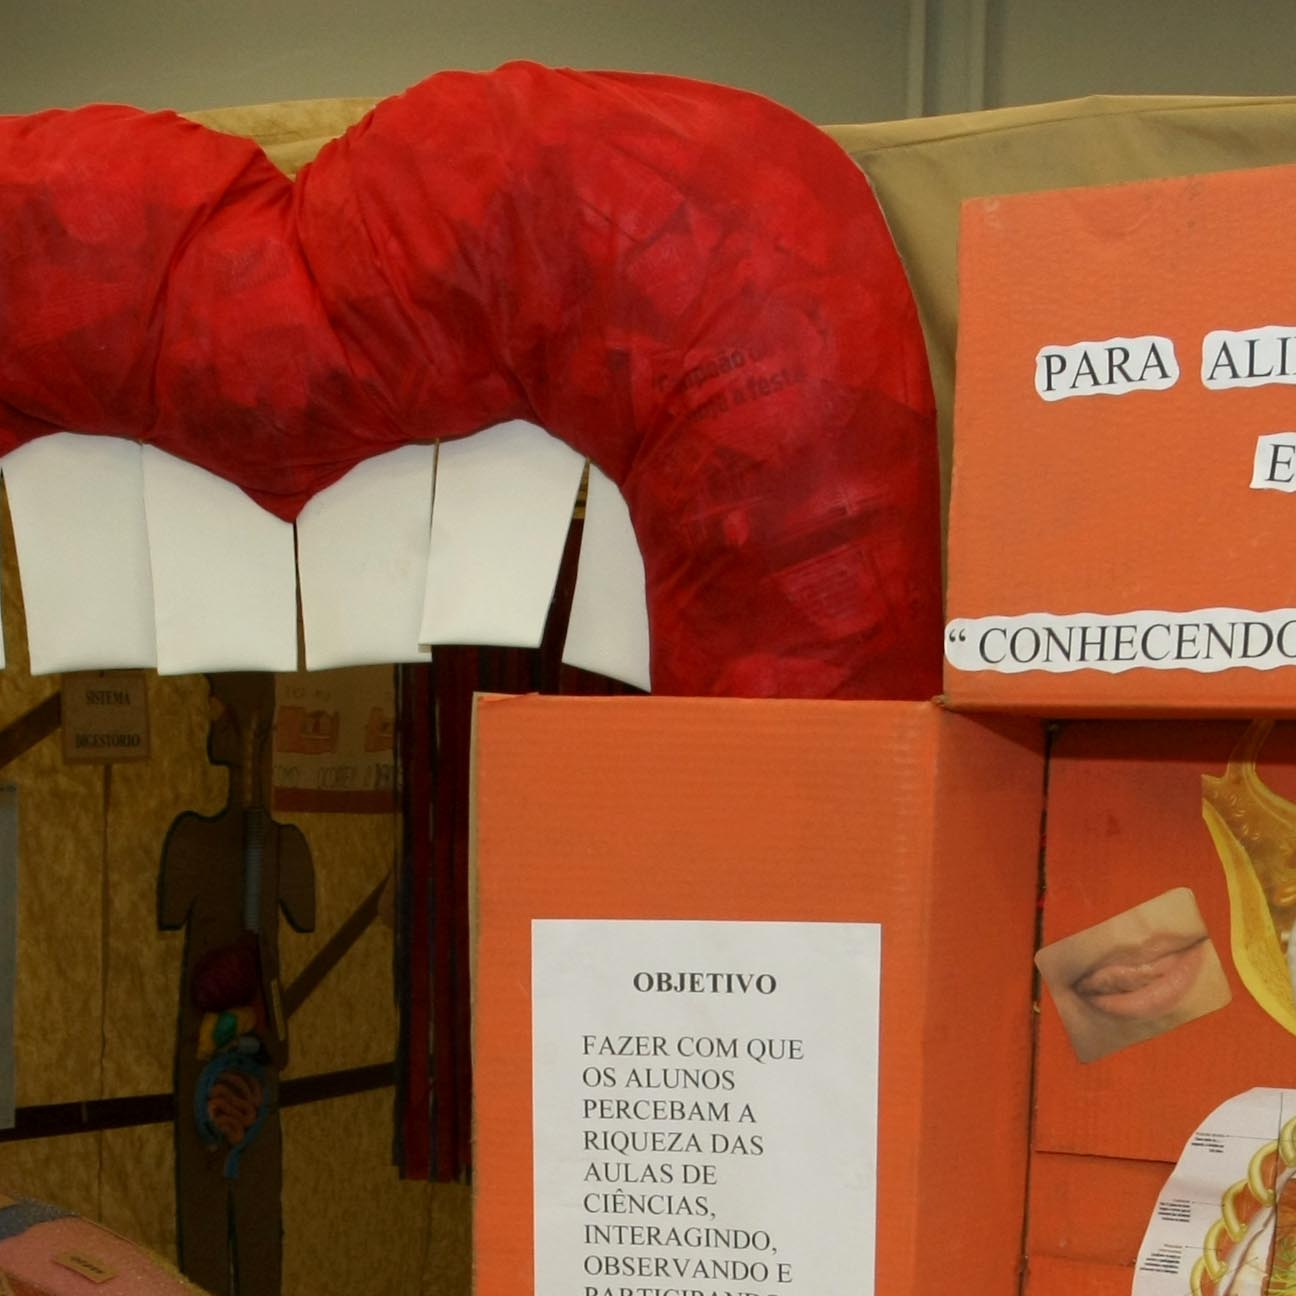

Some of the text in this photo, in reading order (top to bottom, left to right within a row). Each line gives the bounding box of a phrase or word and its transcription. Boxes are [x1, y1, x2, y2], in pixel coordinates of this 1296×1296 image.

[1043, 347, 1171, 394] PARA
[1265, 441, 1296, 484] E
[633, 971, 777, 994] OBJETIVO
[583, 1035, 803, 1063] FAZER COM QUE
[582, 1066, 736, 1090] OS ALUNOS
[583, 1098, 756, 1123] PERCEBAM A
[584, 1130, 764, 1156] RIQUEZA DAS
[585, 1162, 717, 1185] AULAS DE
[583, 1187, 716, 1219] CIÊNCIAS,
[585, 1224, 777, 1255] INTERAGINDO,
[583, 1255, 792, 1283] OBSERVANDO E
